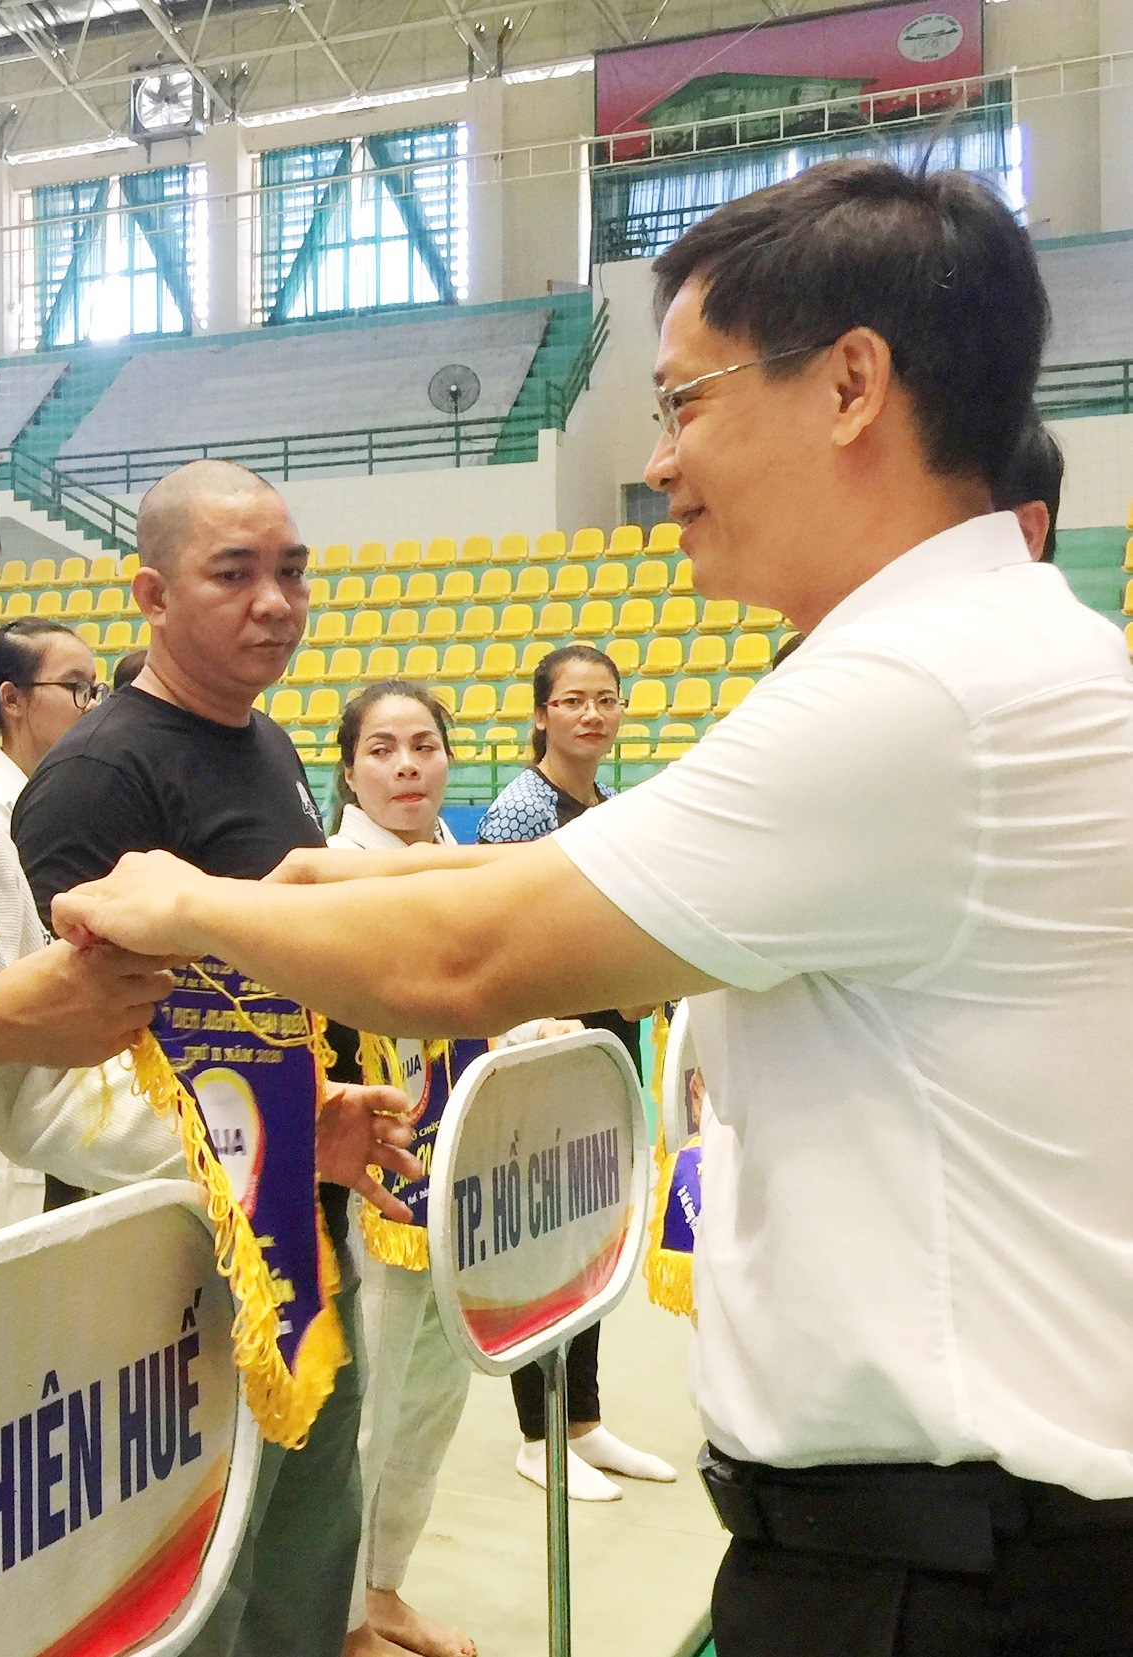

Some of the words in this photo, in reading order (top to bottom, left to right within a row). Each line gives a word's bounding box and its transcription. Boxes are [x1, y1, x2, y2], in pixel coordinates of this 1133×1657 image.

[454, 1174, 486, 1272] TP.
[492, 1129, 521, 1255] HỒ
[527, 1127, 562, 1239] CHÍ
[567, 1126, 620, 1222] MINH
[118, 1287, 202, 1503] HUẾ
